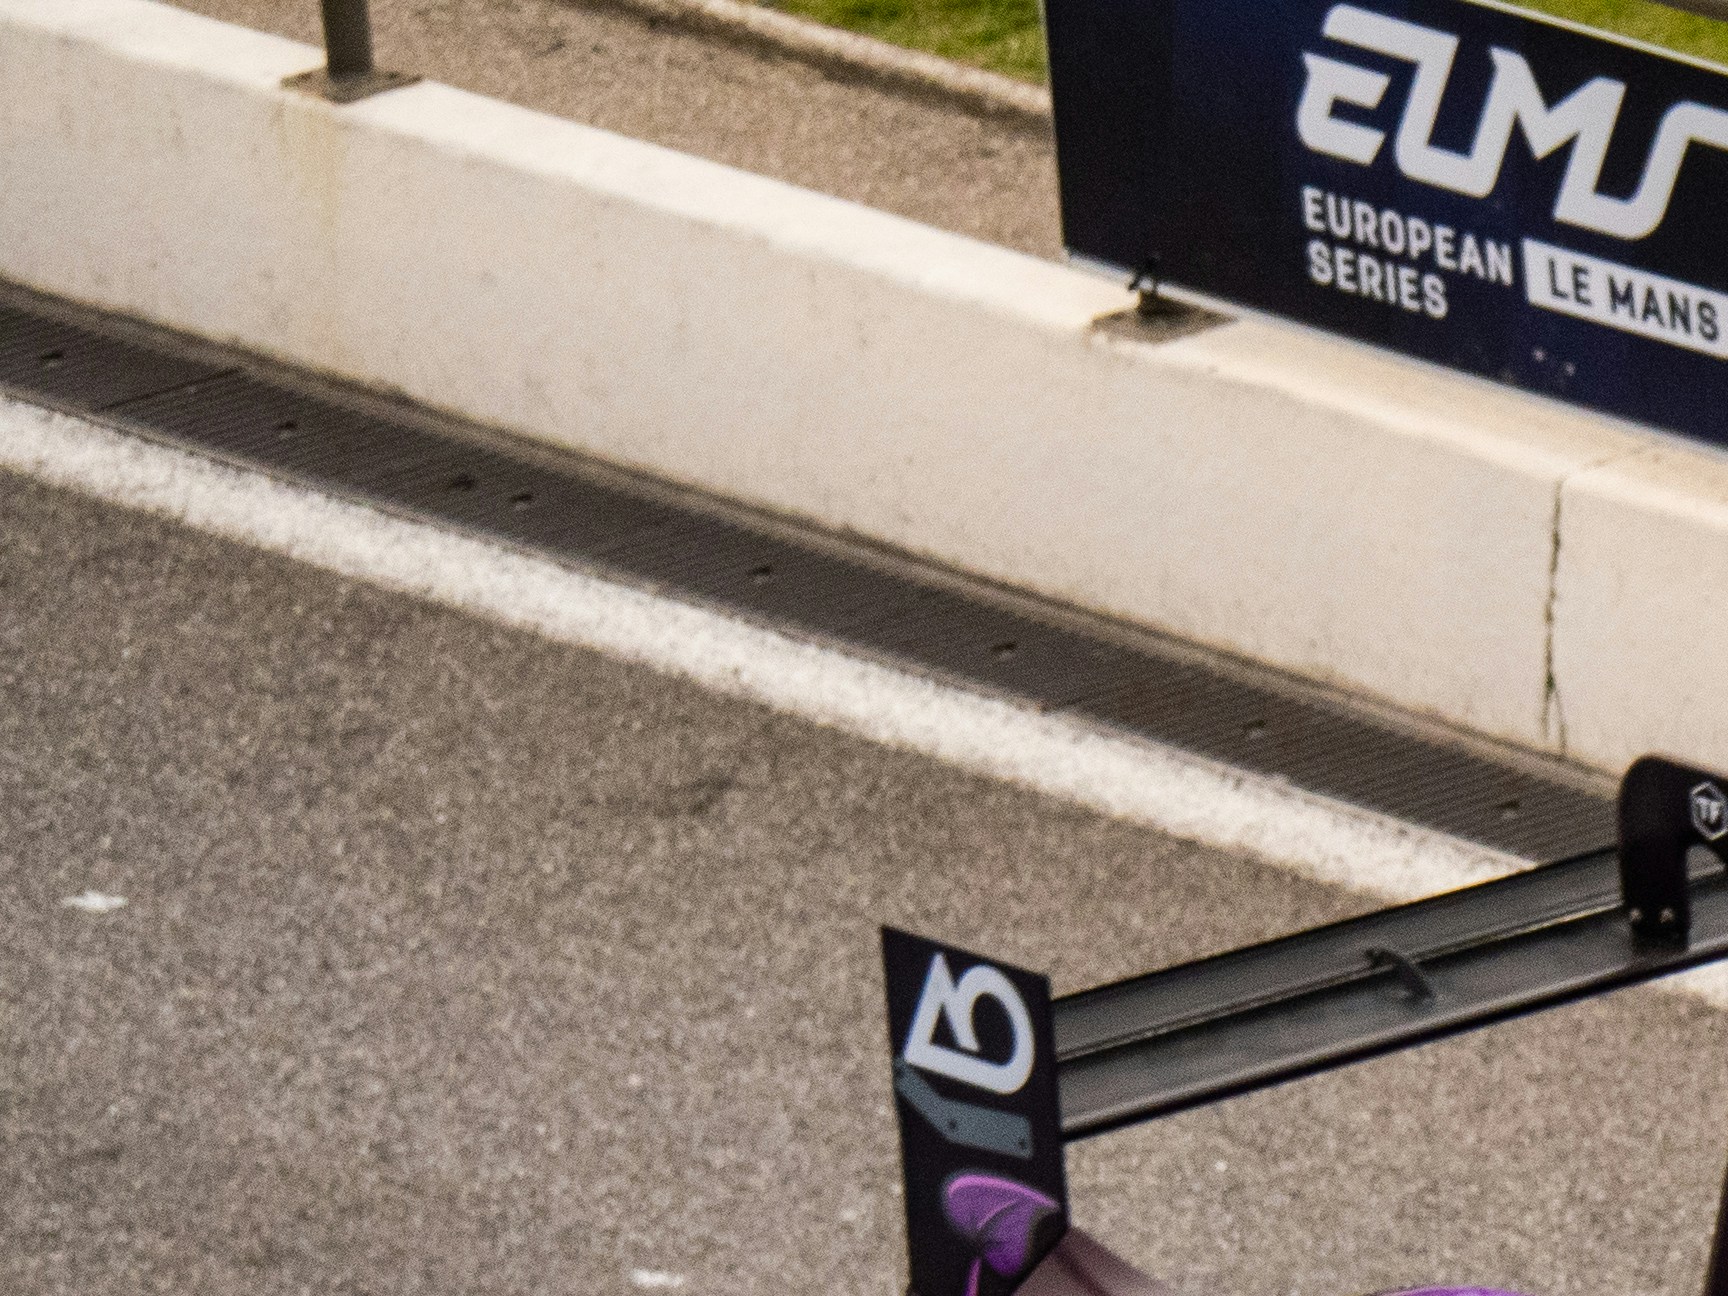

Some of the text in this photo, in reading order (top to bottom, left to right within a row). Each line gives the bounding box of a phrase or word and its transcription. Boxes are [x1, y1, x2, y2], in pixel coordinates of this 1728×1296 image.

[1302, 186, 1722, 344] EUROPEAN LE MANS
[1305, 239, 1450, 321] SERIES
